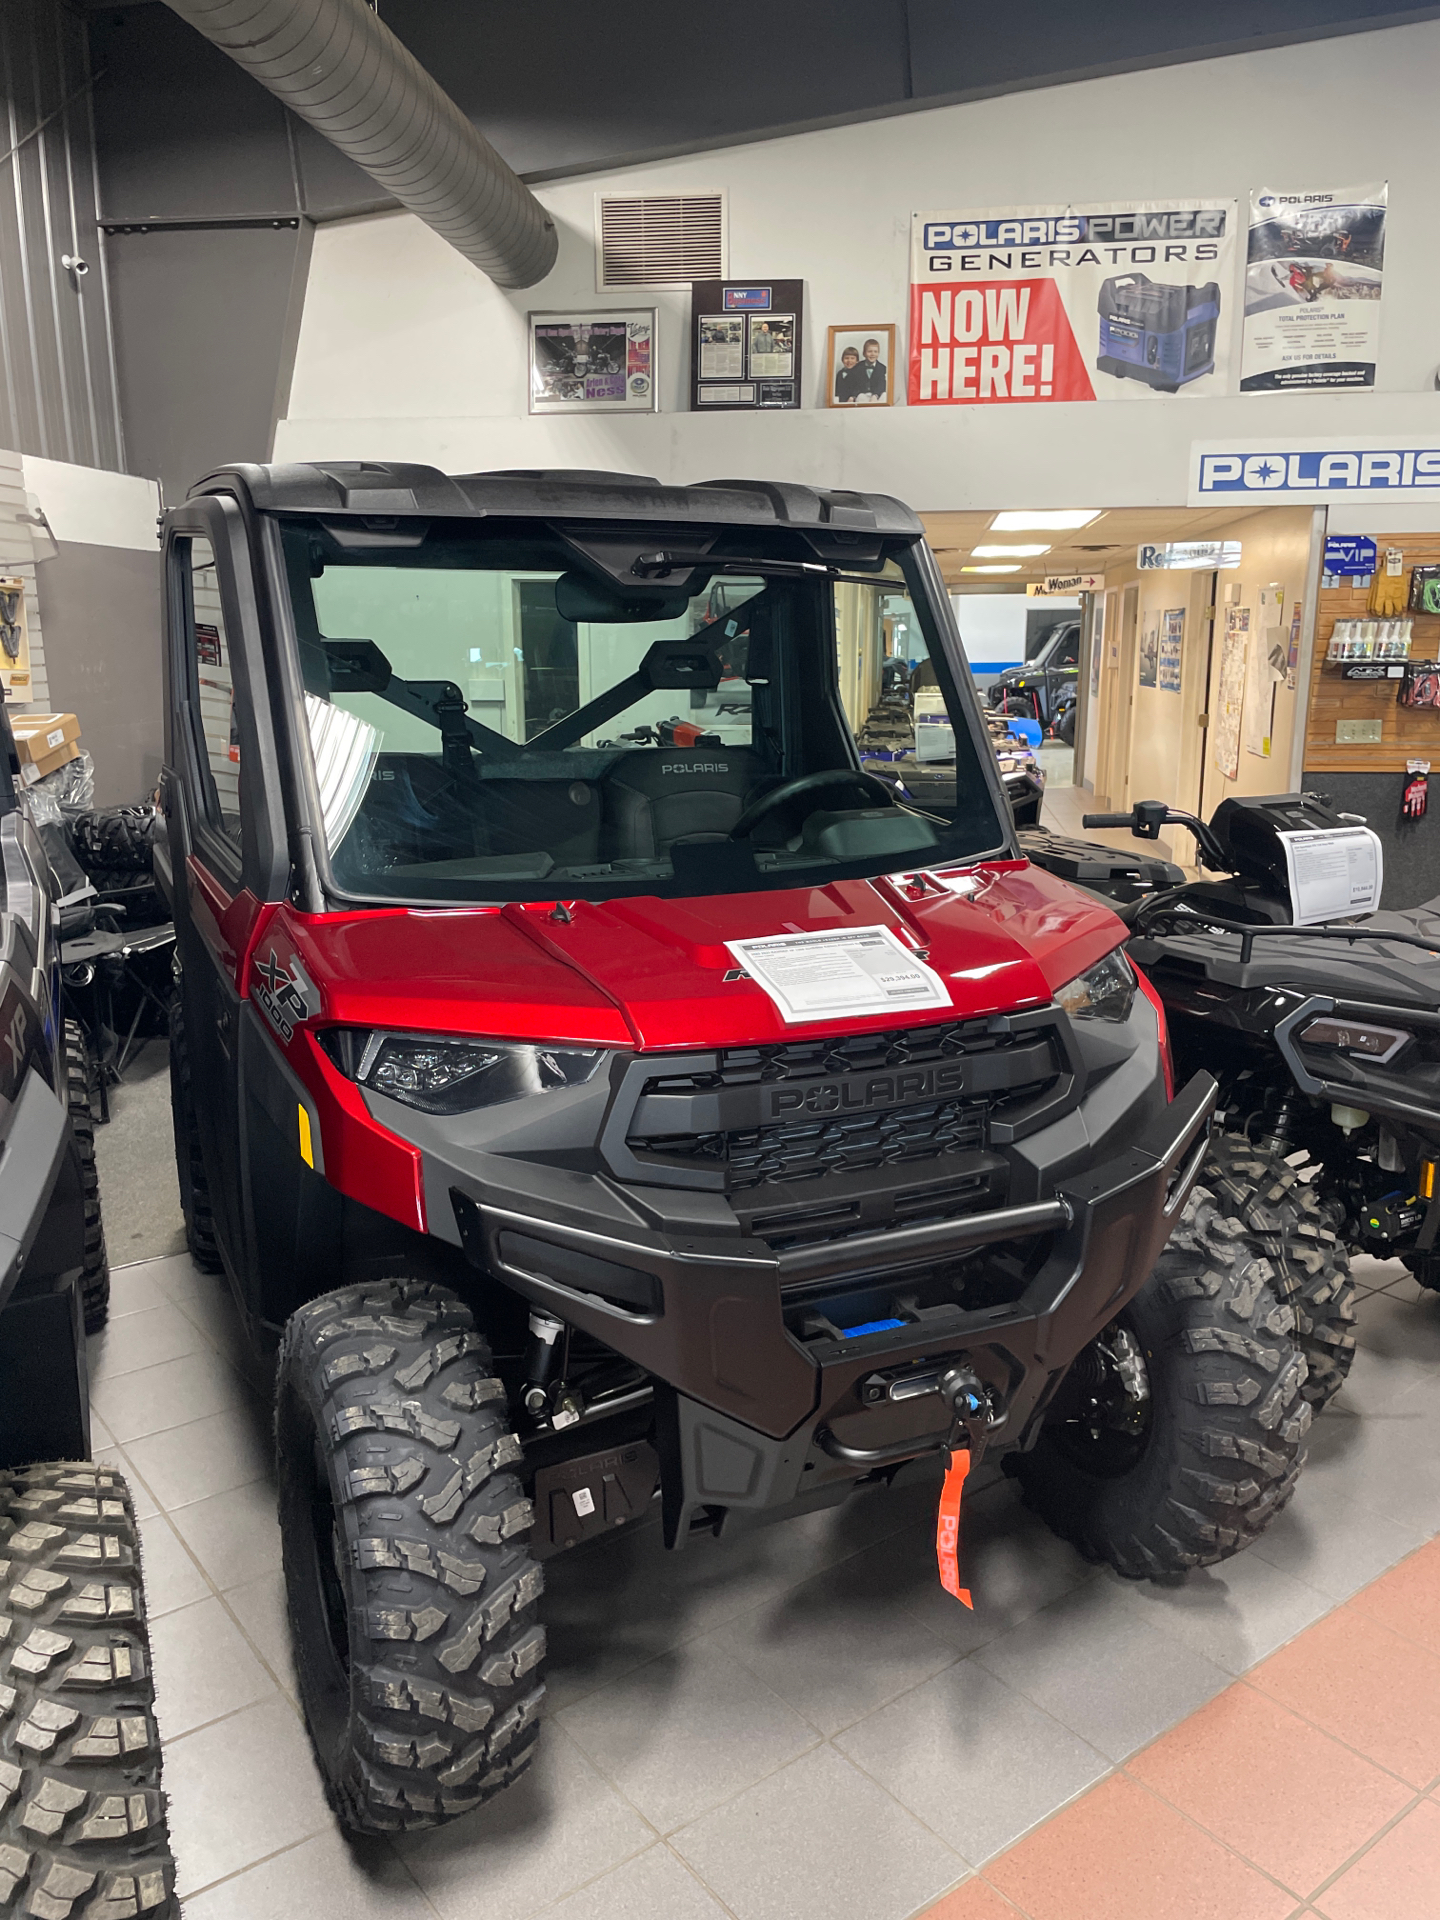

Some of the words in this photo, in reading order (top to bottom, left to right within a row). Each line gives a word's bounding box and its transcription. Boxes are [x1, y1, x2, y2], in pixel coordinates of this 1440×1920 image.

[1279, 195, 1332, 204] POLARIS
[928, 220, 1079, 247] POLARIS
[1089, 213, 1222, 240] POWER
[929, 244, 1218, 271] GENERATORS
[921, 288, 1031, 344] NOW
[1110, 315, 1130, 324] POLARIS
[920, 344, 1054, 400] HERE!
[586, 386, 624, 398] Ness
[1202, 452, 1440, 489] POLARIS
[1340, 549, 1374, 562] VIP
[1048, 576, 1082, 590] Woman
[715, 704, 752, 717] RZ
[662, 763, 728, 774] POLARIS
[255, 948, 308, 1020] XP
[880, 973, 920, 982] $29,394.00
[260, 982, 293, 1042] 1000
[4, 1002, 27, 1079] XP
[771, 1065, 964, 1119] POLARIS
